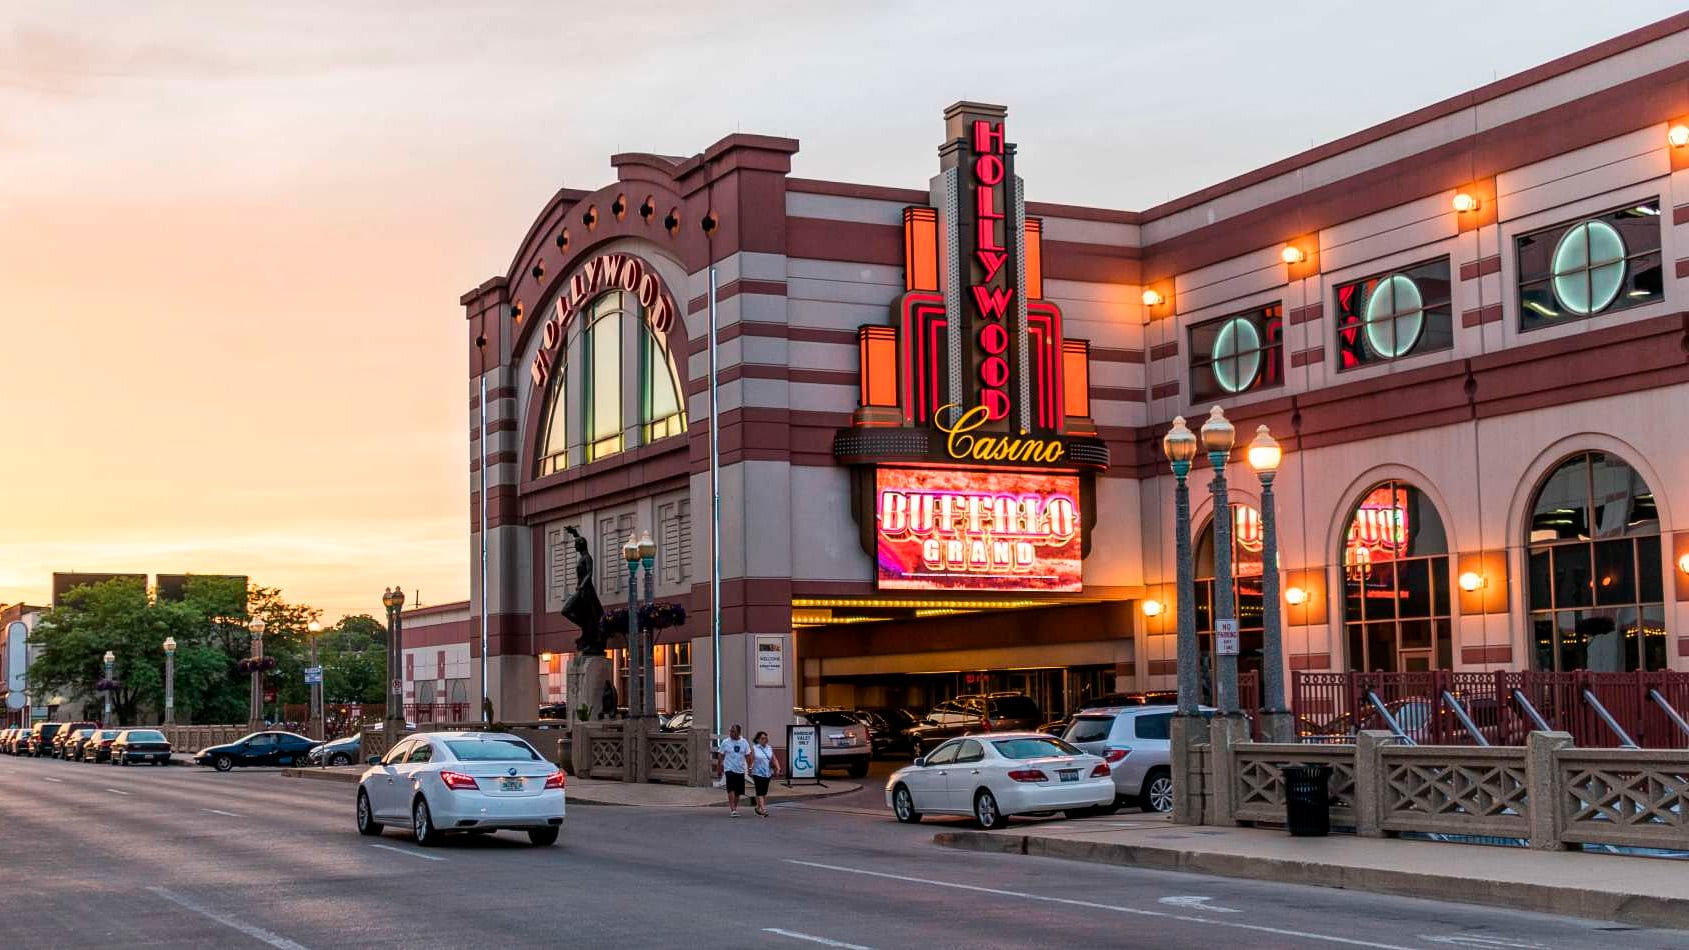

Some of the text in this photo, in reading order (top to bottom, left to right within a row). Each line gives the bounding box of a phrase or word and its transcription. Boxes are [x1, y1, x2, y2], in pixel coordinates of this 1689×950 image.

[972, 119, 1013, 422] HOLLYWOOD
[531, 255, 674, 387] HOLLYWOOD
[935, 404, 1065, 462] Casino
[879, 491, 1077, 544] BUFFALO
[922, 537, 1037, 571] GRAND
